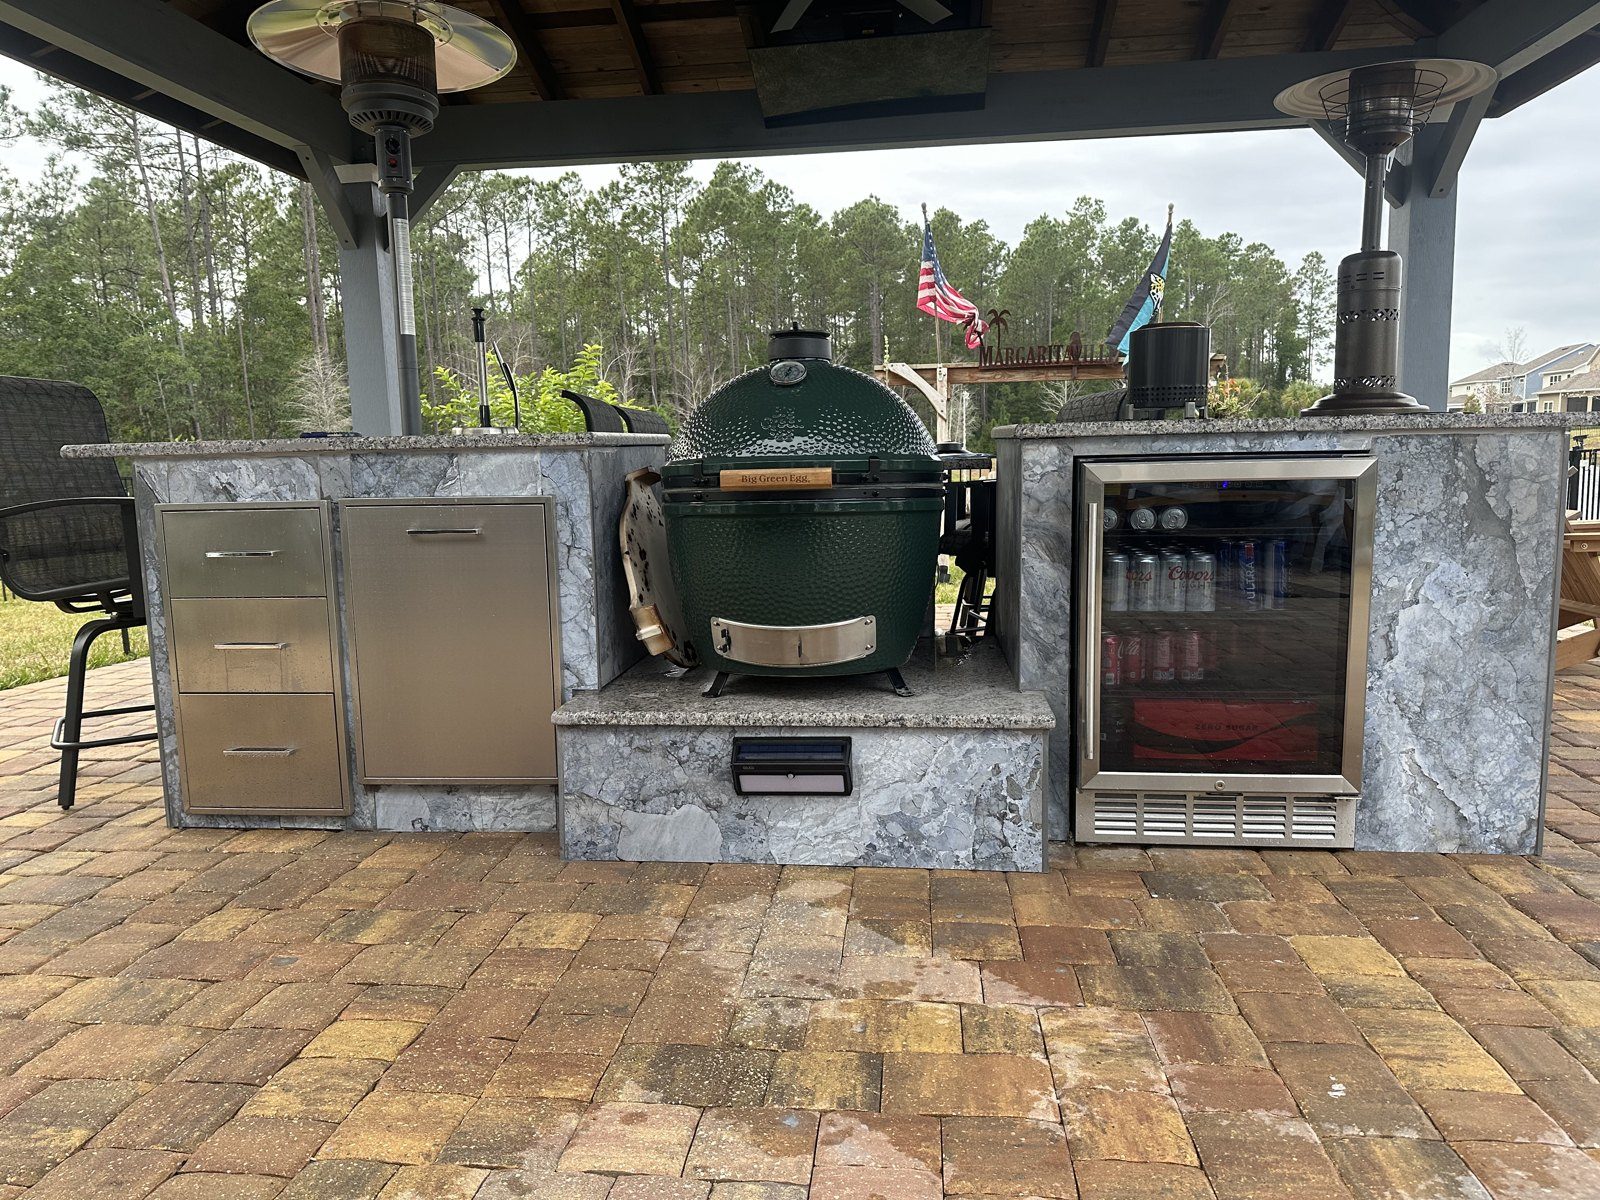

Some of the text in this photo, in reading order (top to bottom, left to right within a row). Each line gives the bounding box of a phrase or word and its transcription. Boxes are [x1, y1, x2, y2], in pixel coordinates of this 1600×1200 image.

[741, 474, 758, 484] Big
[759, 474, 788, 483] Green
[1244, 561, 1256, 600] ULTRA
[1194, 722, 1223, 731] ZERO
